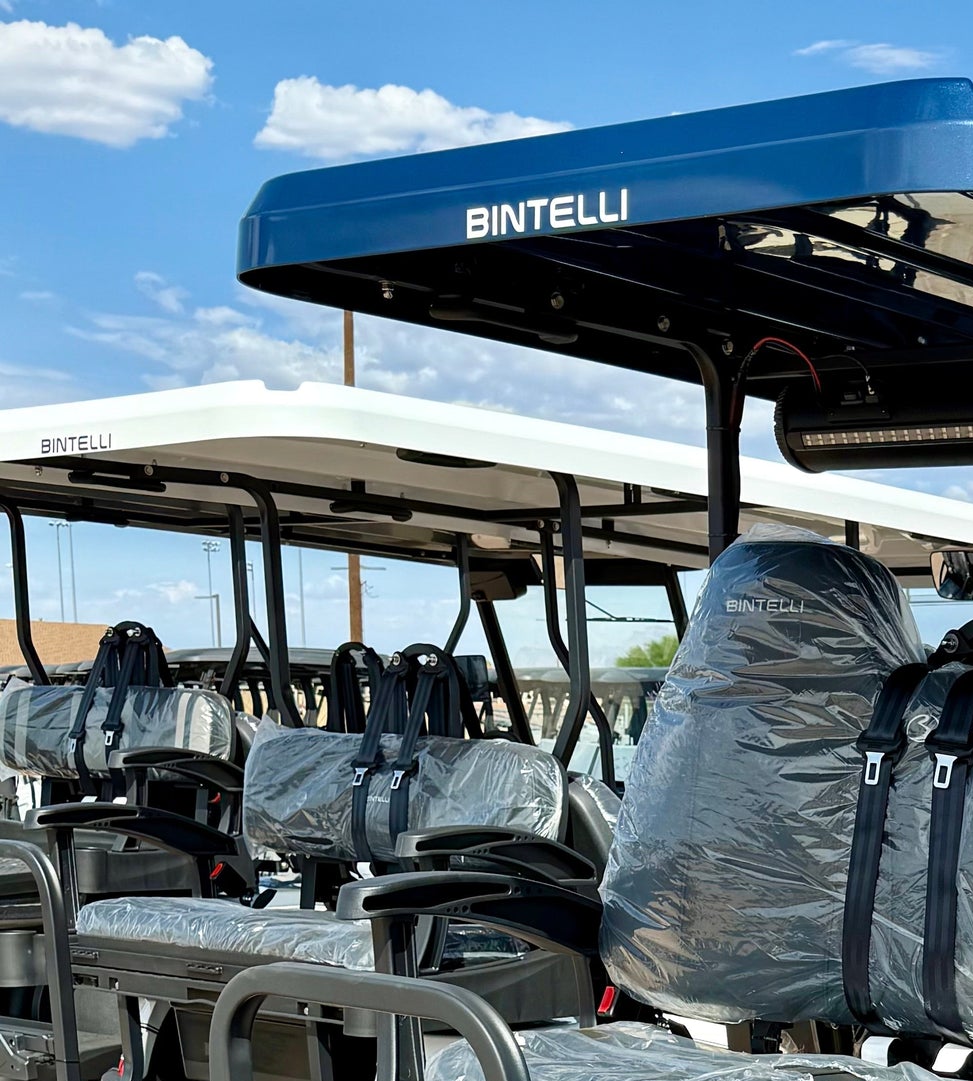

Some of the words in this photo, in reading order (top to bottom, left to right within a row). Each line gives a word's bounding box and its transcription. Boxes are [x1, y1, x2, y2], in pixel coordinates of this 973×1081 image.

[466, 188, 629, 240] BINTELLI
[41, 432, 112, 454] BINTELLI
[726, 598, 804, 614] BINTELLI
